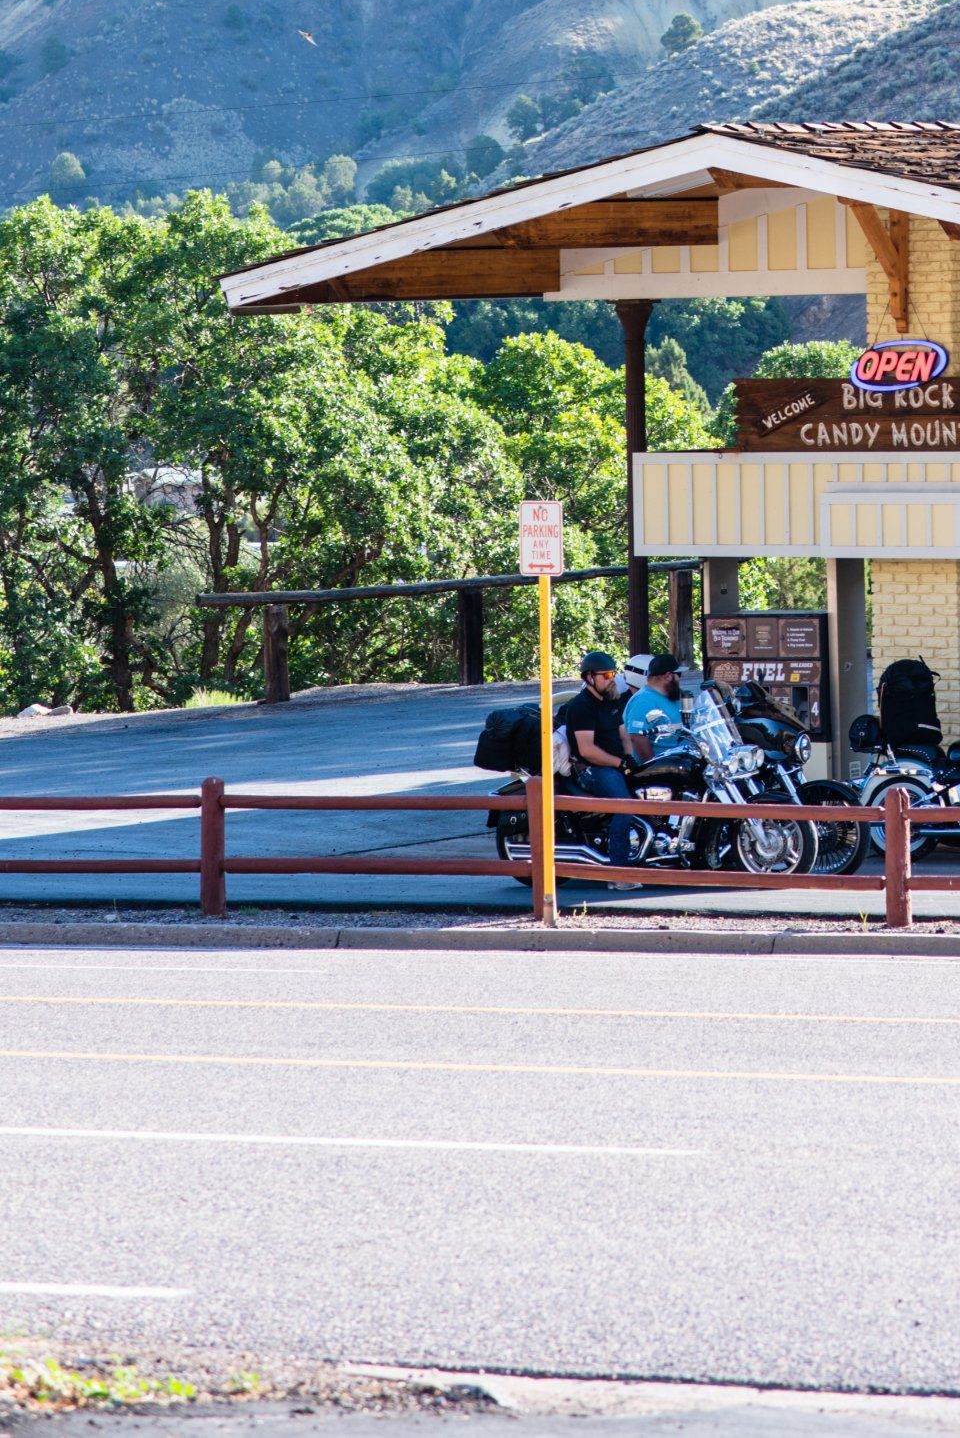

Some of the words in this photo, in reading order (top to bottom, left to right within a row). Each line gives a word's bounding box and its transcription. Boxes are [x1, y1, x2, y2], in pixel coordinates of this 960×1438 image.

[858, 352, 936, 382] OPEN
[842, 383, 883, 410] BIG
[895, 384, 955, 409] ROCK
[762, 394, 816, 430] WELCOME
[800, 422, 881, 448] CANDY
[533, 508, 548, 521] NO
[523, 524, 559, 538] PARKING
[533, 540, 548, 548] ANY
[532, 550, 551, 560] TIME
[741, 663, 785, 681] FUEL
[811, 702, 819, 716] 4
